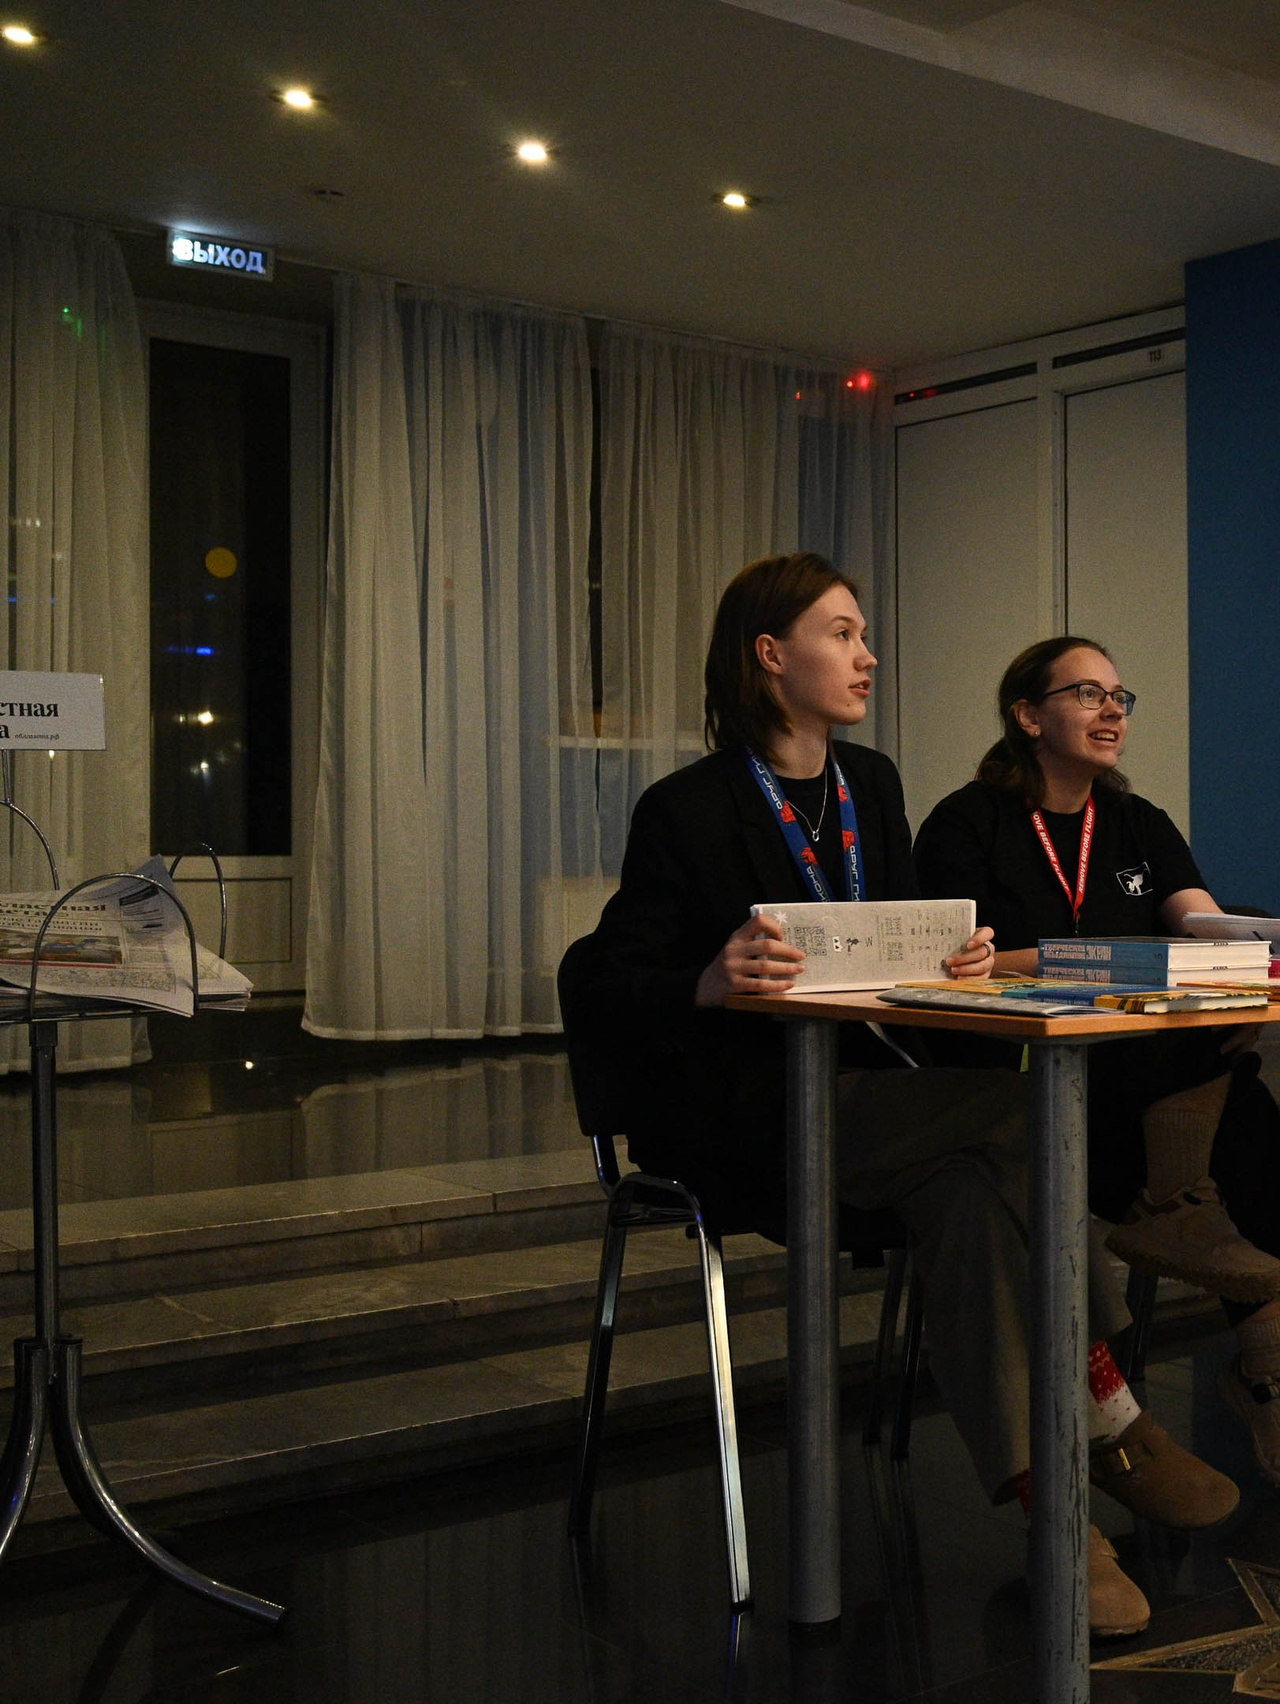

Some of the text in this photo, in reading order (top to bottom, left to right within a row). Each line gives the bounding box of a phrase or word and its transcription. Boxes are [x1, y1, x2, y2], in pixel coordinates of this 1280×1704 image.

[172, 238, 265, 273] ВЫХОД
[1040, 832, 1057, 862] BEFORE
[1052, 863, 1070, 891] FLIGHT
[1079, 806, 1094, 893] REMOVE BEFORE FLIGHT
[1086, 945, 1111, 960] ЭКРАН
